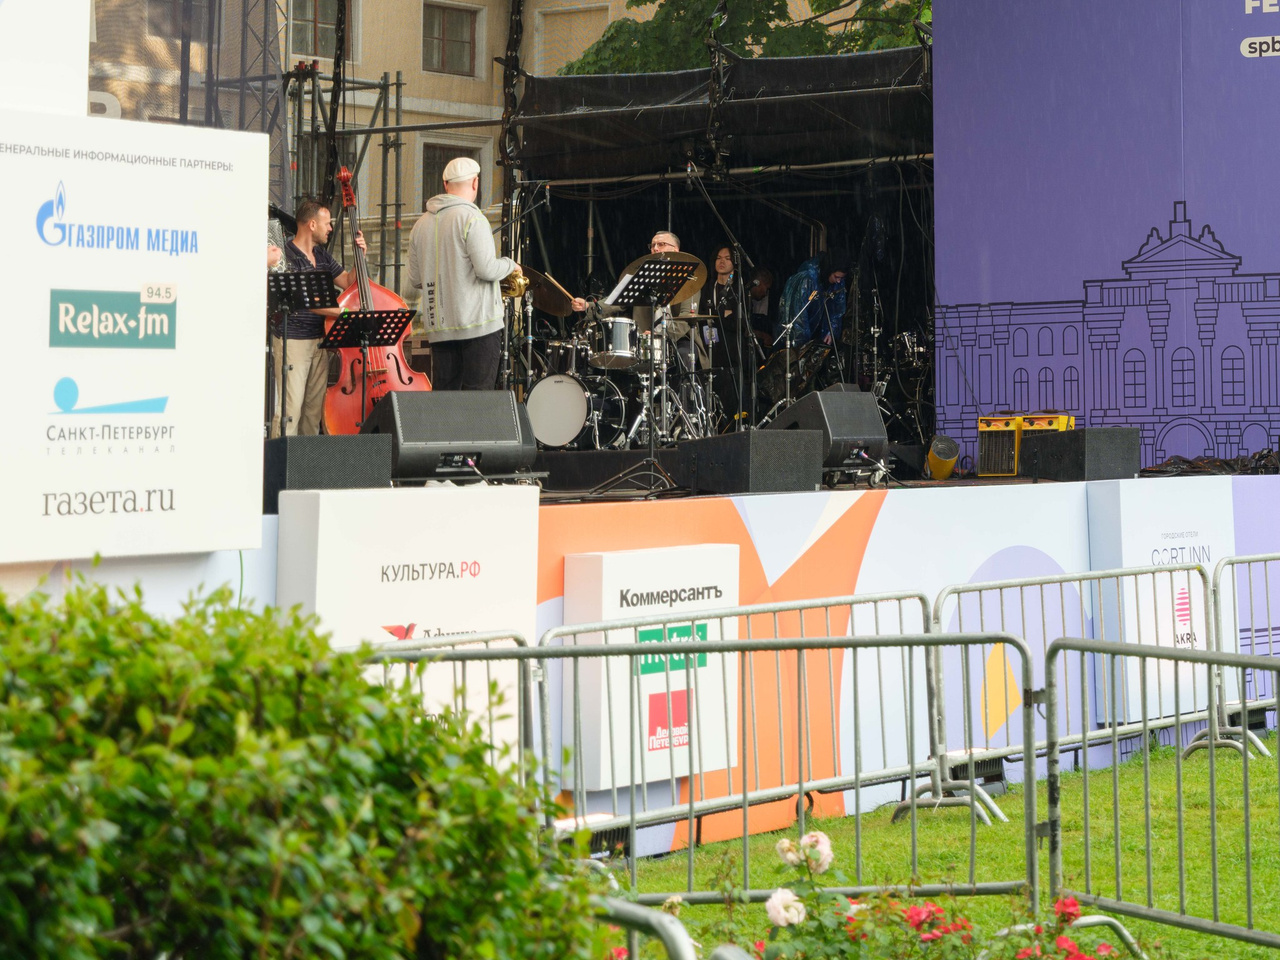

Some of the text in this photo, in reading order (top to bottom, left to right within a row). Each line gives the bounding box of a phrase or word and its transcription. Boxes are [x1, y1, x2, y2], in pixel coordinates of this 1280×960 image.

[0, 143, 234, 172] ЕНЕРАЛЬНЫЕ ИНФОРМАЦИОННЫЕ ПАРТНЕРЫ:
[68, 223, 199, 257] ГАЗПРОМ МЕДИА
[146, 286, 172, 299] 94.5
[42, 487, 176, 517] газета.ru
[1151, 545, 1211, 566] CORT INN
[381, 560, 481, 583] КУЛЬТУРА.РФ
[619, 585, 723, 608] Коммерсантъ
[649, 734, 689, 750] Петебур
